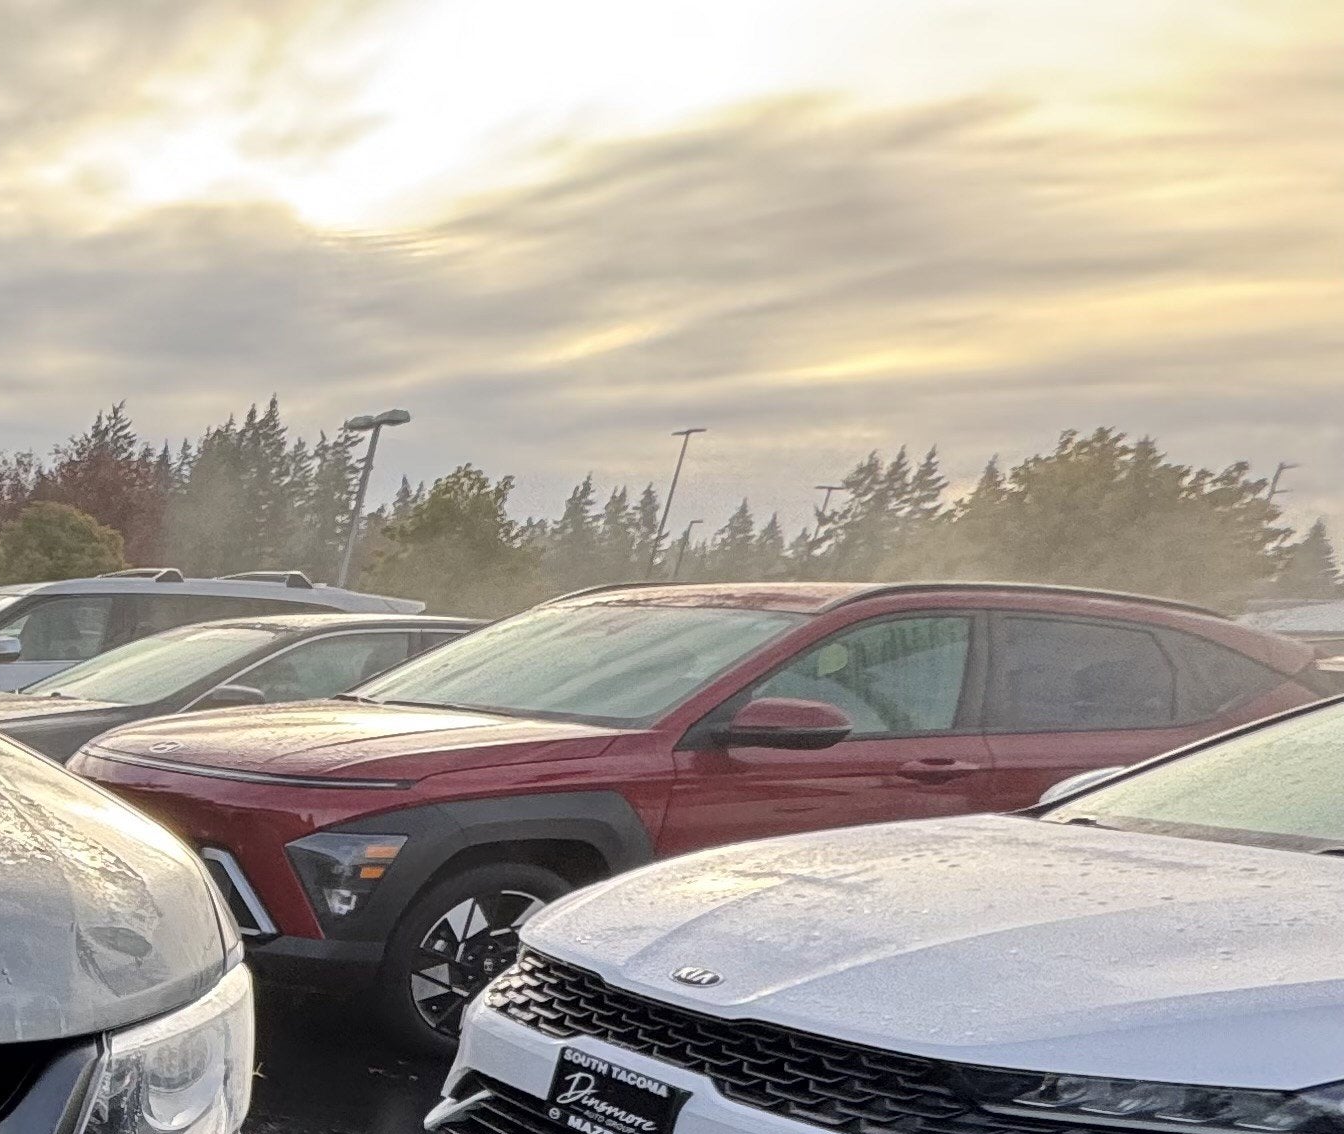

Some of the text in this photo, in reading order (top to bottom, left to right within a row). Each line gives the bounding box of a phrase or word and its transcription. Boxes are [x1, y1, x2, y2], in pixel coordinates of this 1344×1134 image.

[563, 1049, 669, 1098] SOUTH TACOMA
[556, 1072, 658, 1131] Dinsmore
